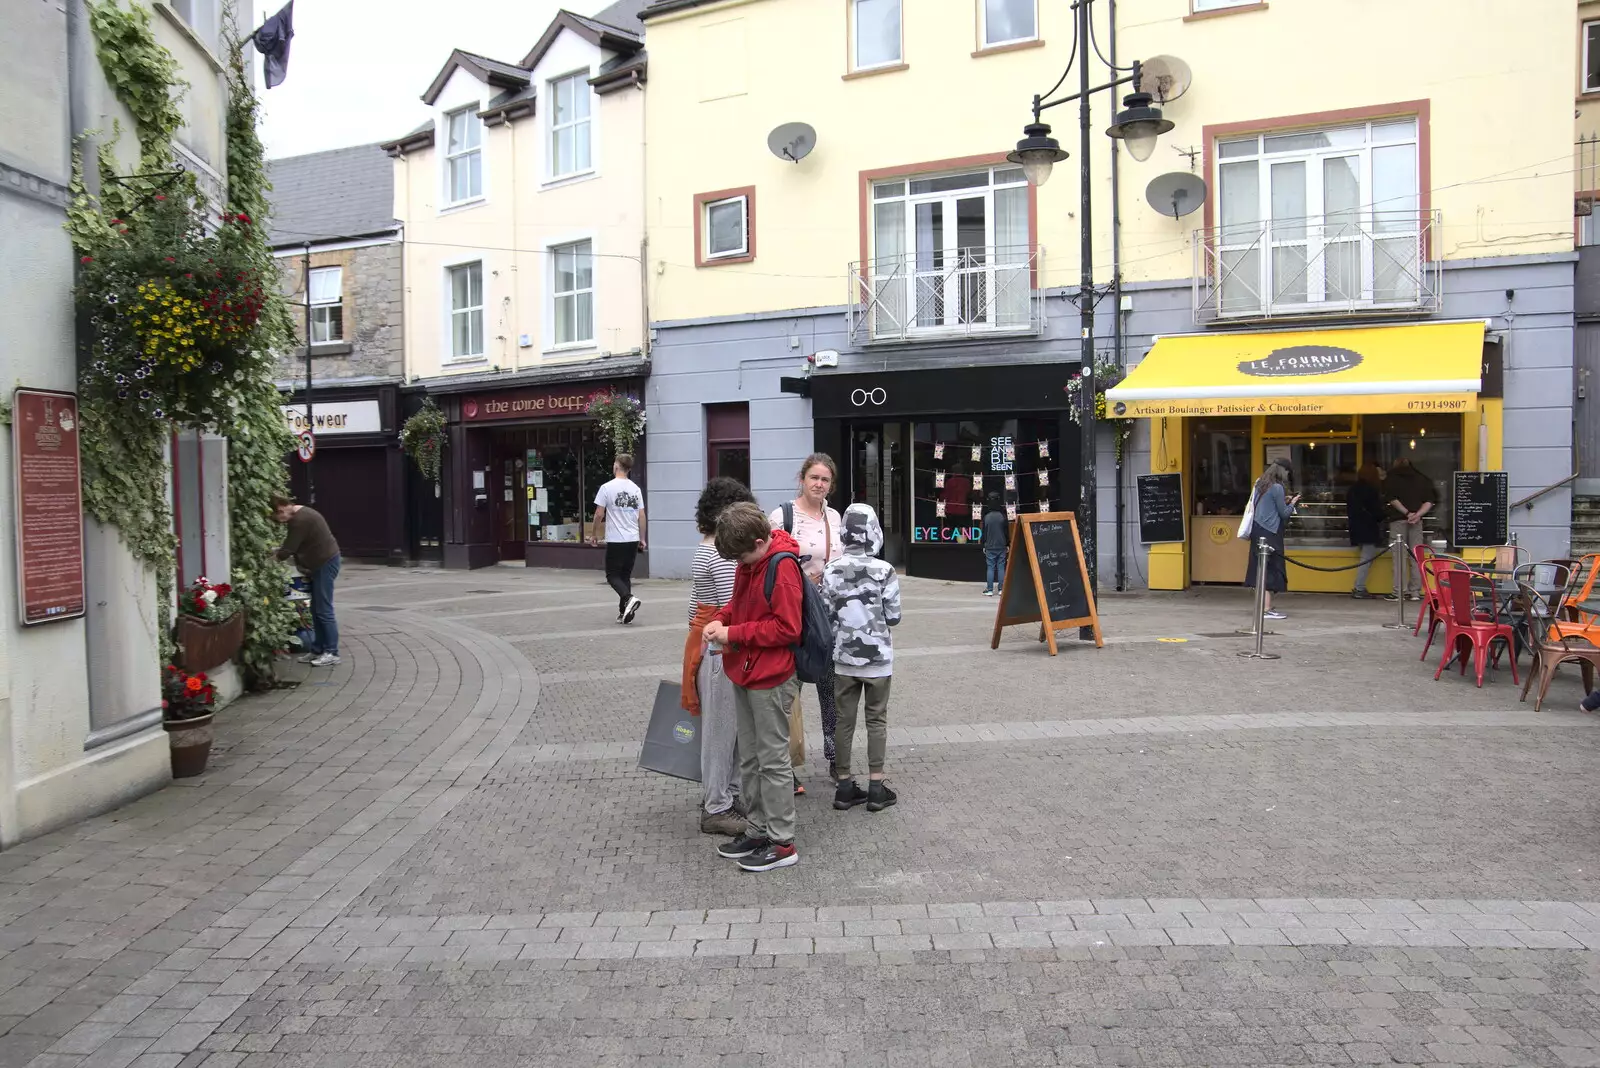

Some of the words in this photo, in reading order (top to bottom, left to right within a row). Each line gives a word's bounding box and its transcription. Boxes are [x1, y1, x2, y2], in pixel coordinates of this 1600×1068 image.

[1251, 360, 1269, 370] LE
[1279, 354, 1350, 366] FOURNIL
[485, 400, 509, 413] the
[512, 398, 545, 411] wine
[548, 395, 584, 410] buff
[1133, 404, 1166, 415] Artisan
[1168, 404, 1214, 414] Boulanger
[1217, 403, 1254, 413] Patissier
[1257, 403, 1266, 412] &
[1269, 402, 1324, 412] Chocolatier
[1407, 400, 1467, 409] 0719149807
[990, 436, 1012, 446] SEE
[990, 452, 1013, 464] BE
[915, 527, 938, 540] EYE
